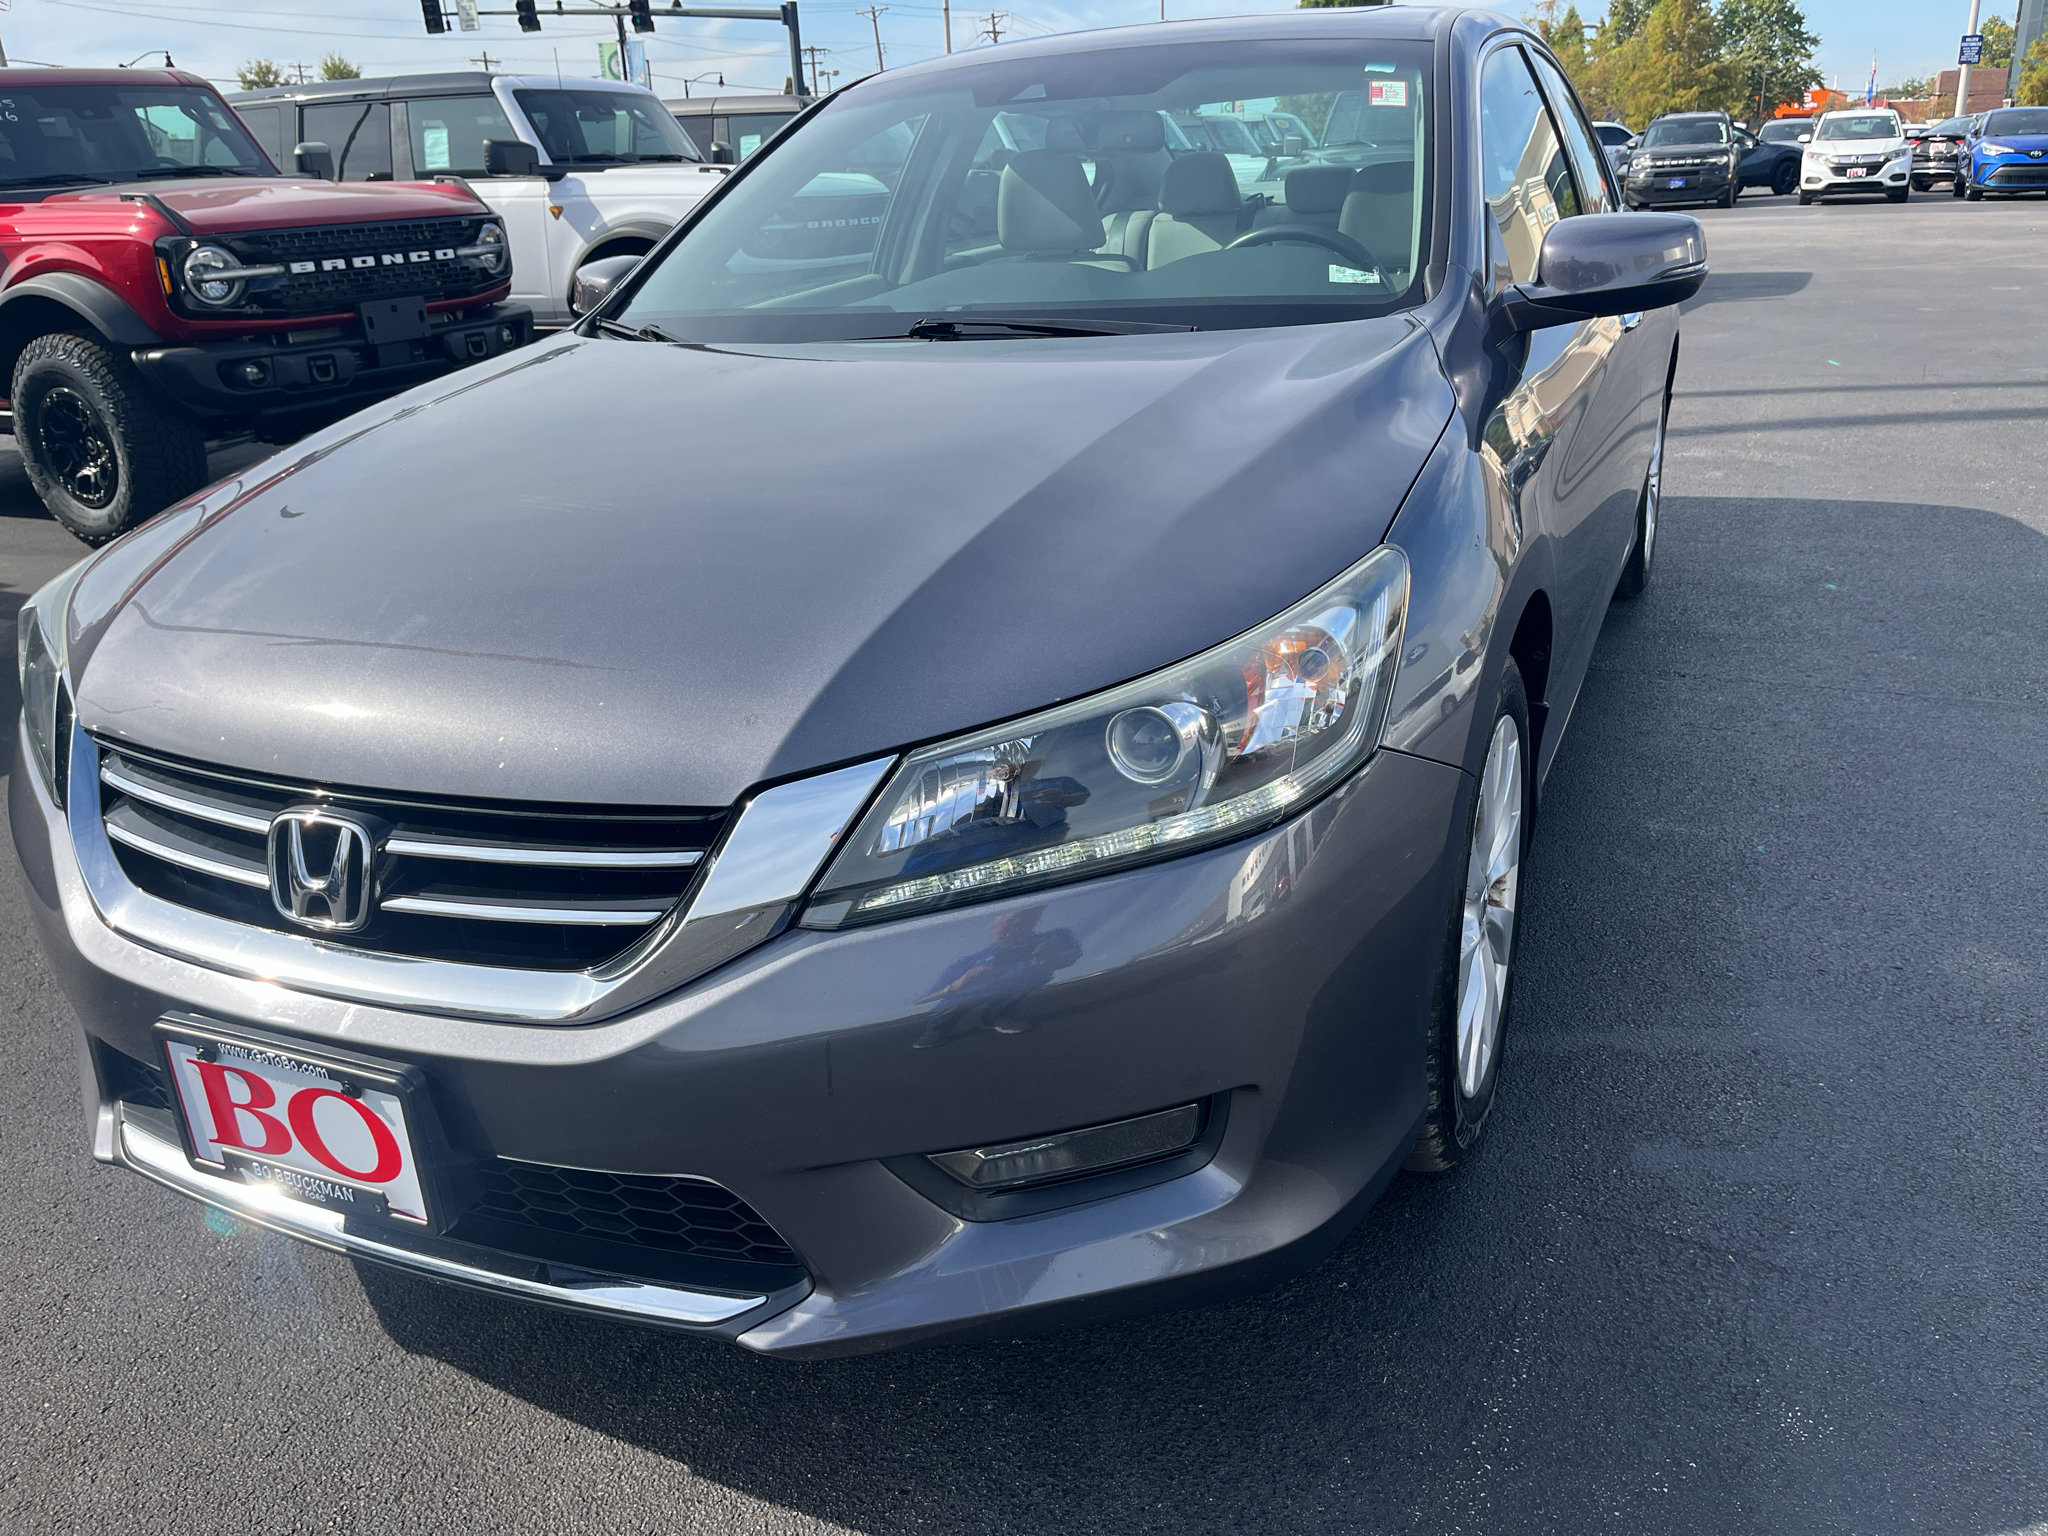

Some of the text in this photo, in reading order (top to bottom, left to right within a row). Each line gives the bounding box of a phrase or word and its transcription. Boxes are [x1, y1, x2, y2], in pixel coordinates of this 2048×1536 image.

[0, 110, 18, 122] 6
[807, 216, 880, 229] BRONCO
[290, 248, 456, 274] BRONCO
[217, 1042, 330, 1080] www.GoToBo.com
[186, 1058, 403, 1184] BO
[252, 1161, 354, 1203] BO BEUCKMAN
